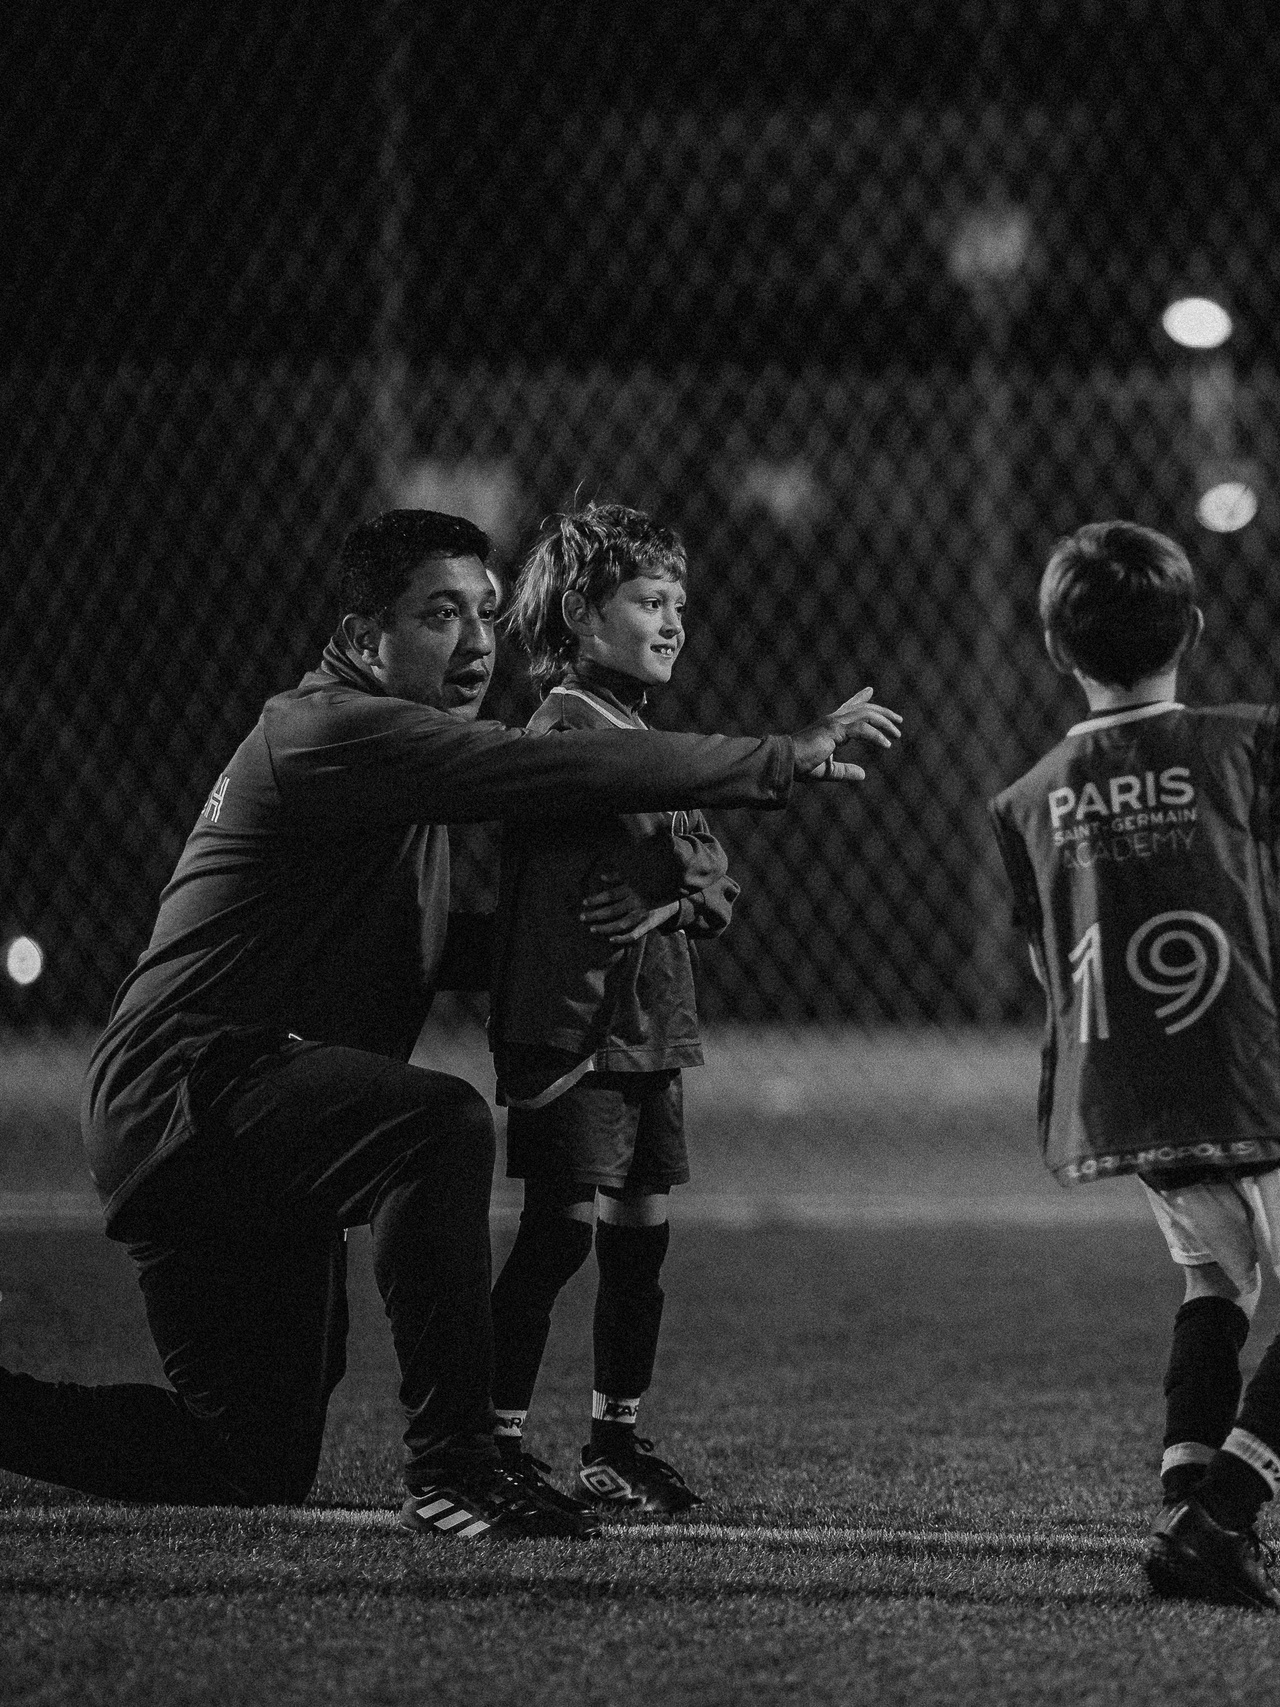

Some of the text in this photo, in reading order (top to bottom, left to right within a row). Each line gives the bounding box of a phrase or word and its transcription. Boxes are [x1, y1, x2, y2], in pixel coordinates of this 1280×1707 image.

[1047, 766, 1195, 829] PARIS
[1053, 807, 1197, 847] SAINT-GERMAIN
[1063, 827, 1197, 869] ACADEMY
[1067, 909, 1231, 1044] 19
